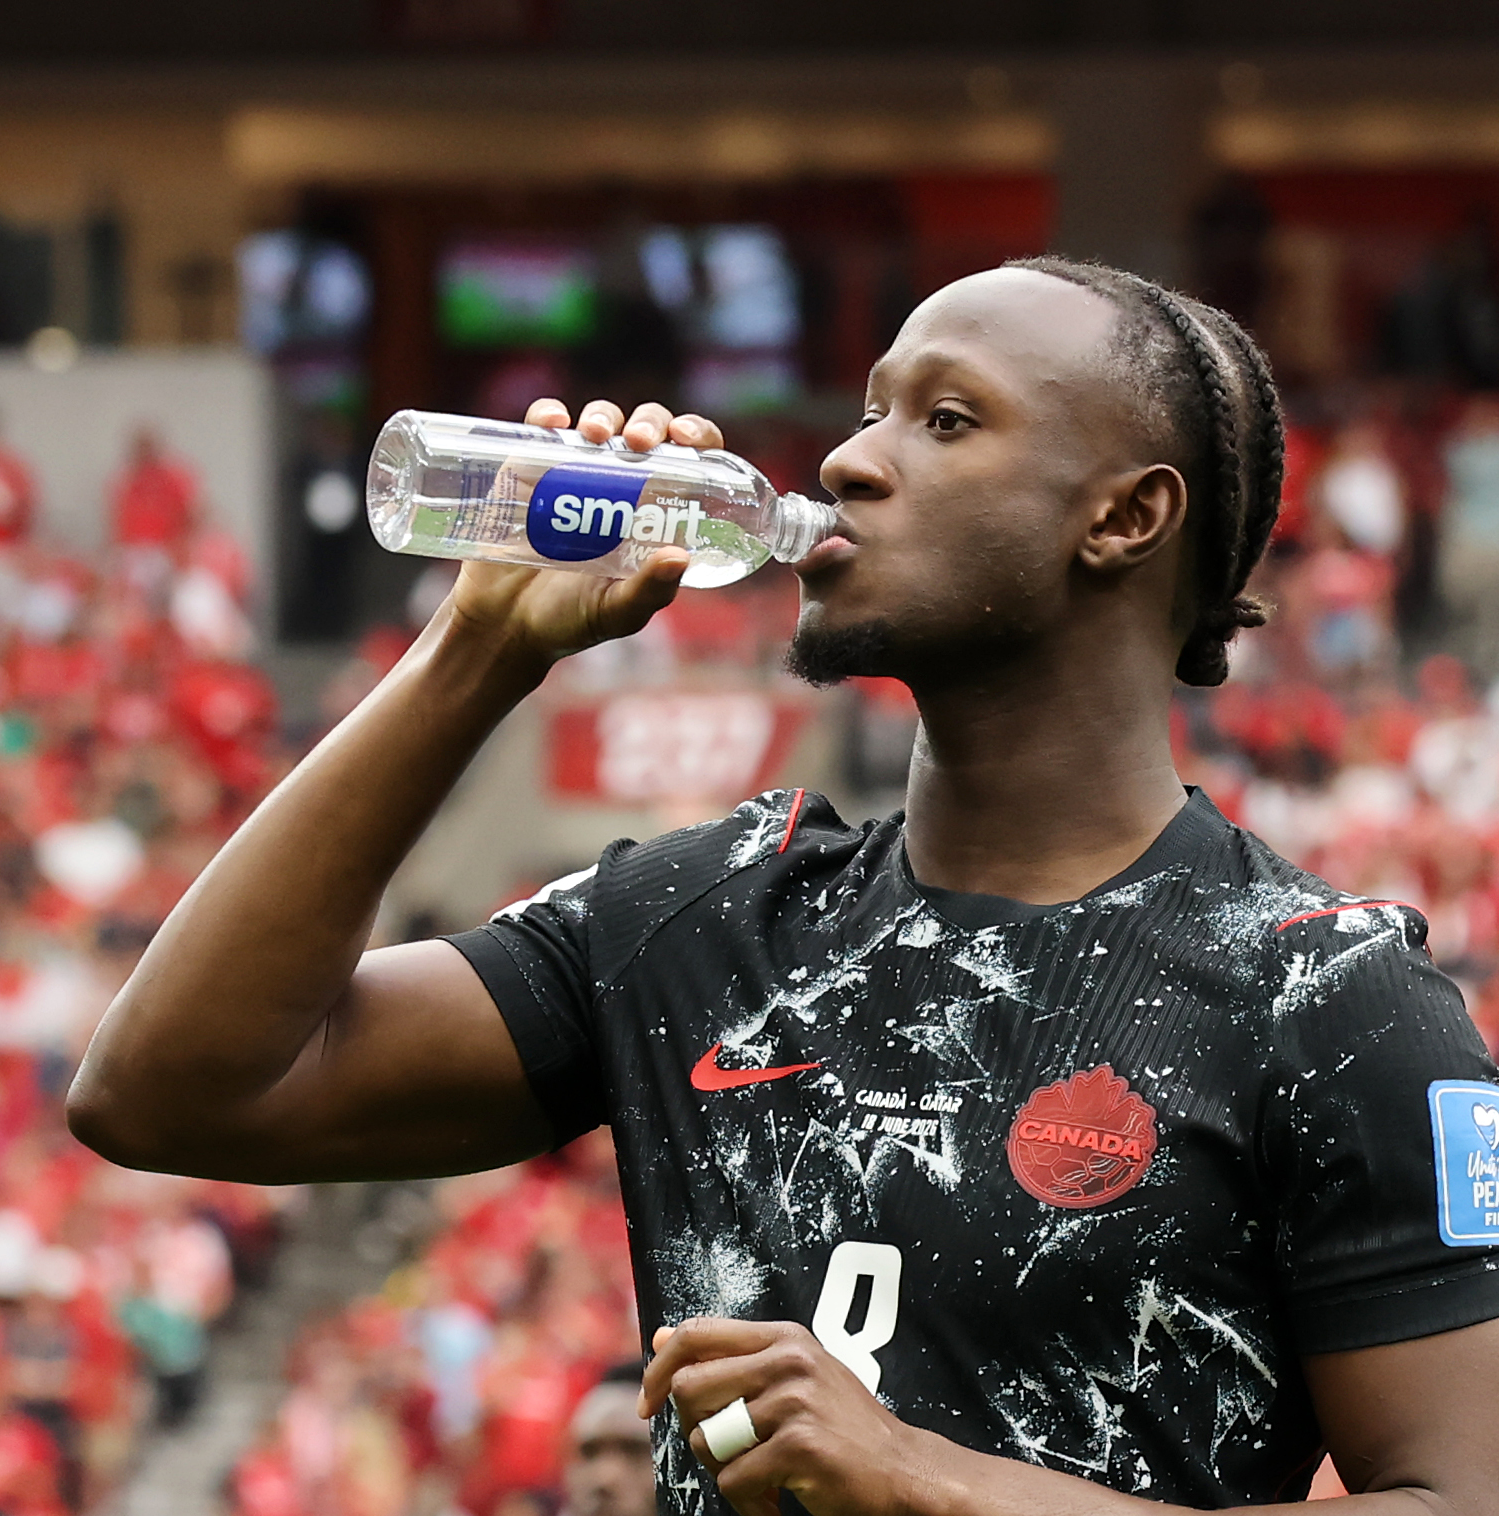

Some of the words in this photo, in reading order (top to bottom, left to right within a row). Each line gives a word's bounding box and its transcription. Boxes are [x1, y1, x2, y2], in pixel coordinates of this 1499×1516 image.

[550, 493, 707, 547] smart
[855, 1089, 907, 1110] CANADA
[919, 1093, 964, 1113] QATAR
[877, 1115, 911, 1133] JUNE
[1019, 1121, 1142, 1160] CANADA
[812, 1241, 903, 1397] 8
